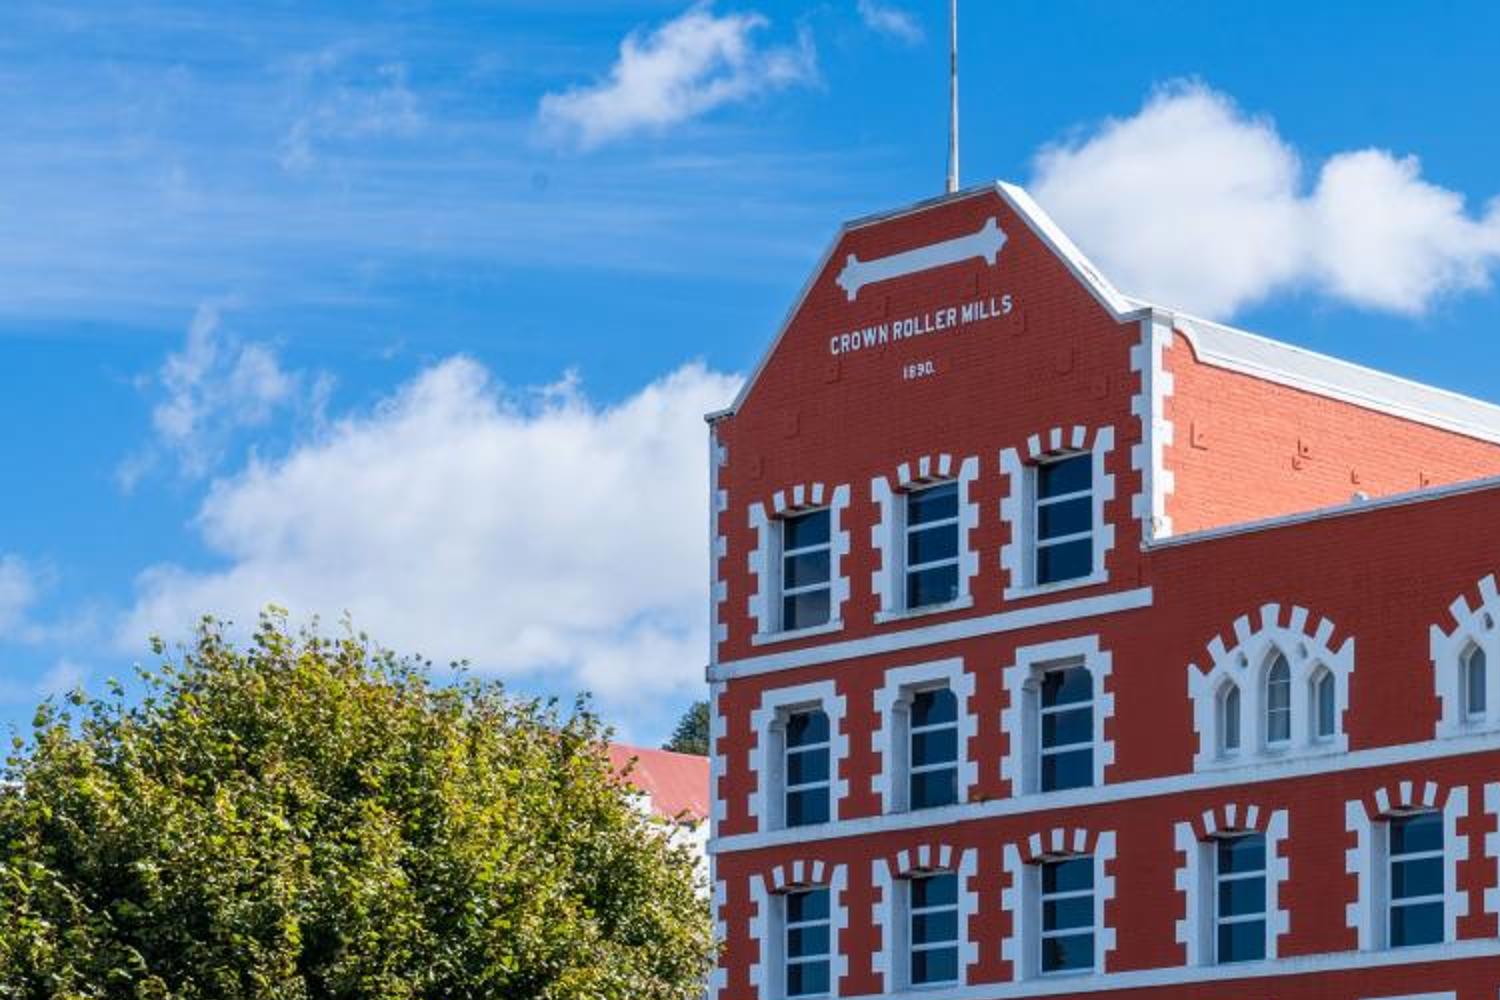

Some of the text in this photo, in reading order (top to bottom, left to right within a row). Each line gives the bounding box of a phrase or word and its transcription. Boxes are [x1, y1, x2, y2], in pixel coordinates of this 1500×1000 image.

[830, 295, 1013, 355] CROWN ROLLER MILLS
